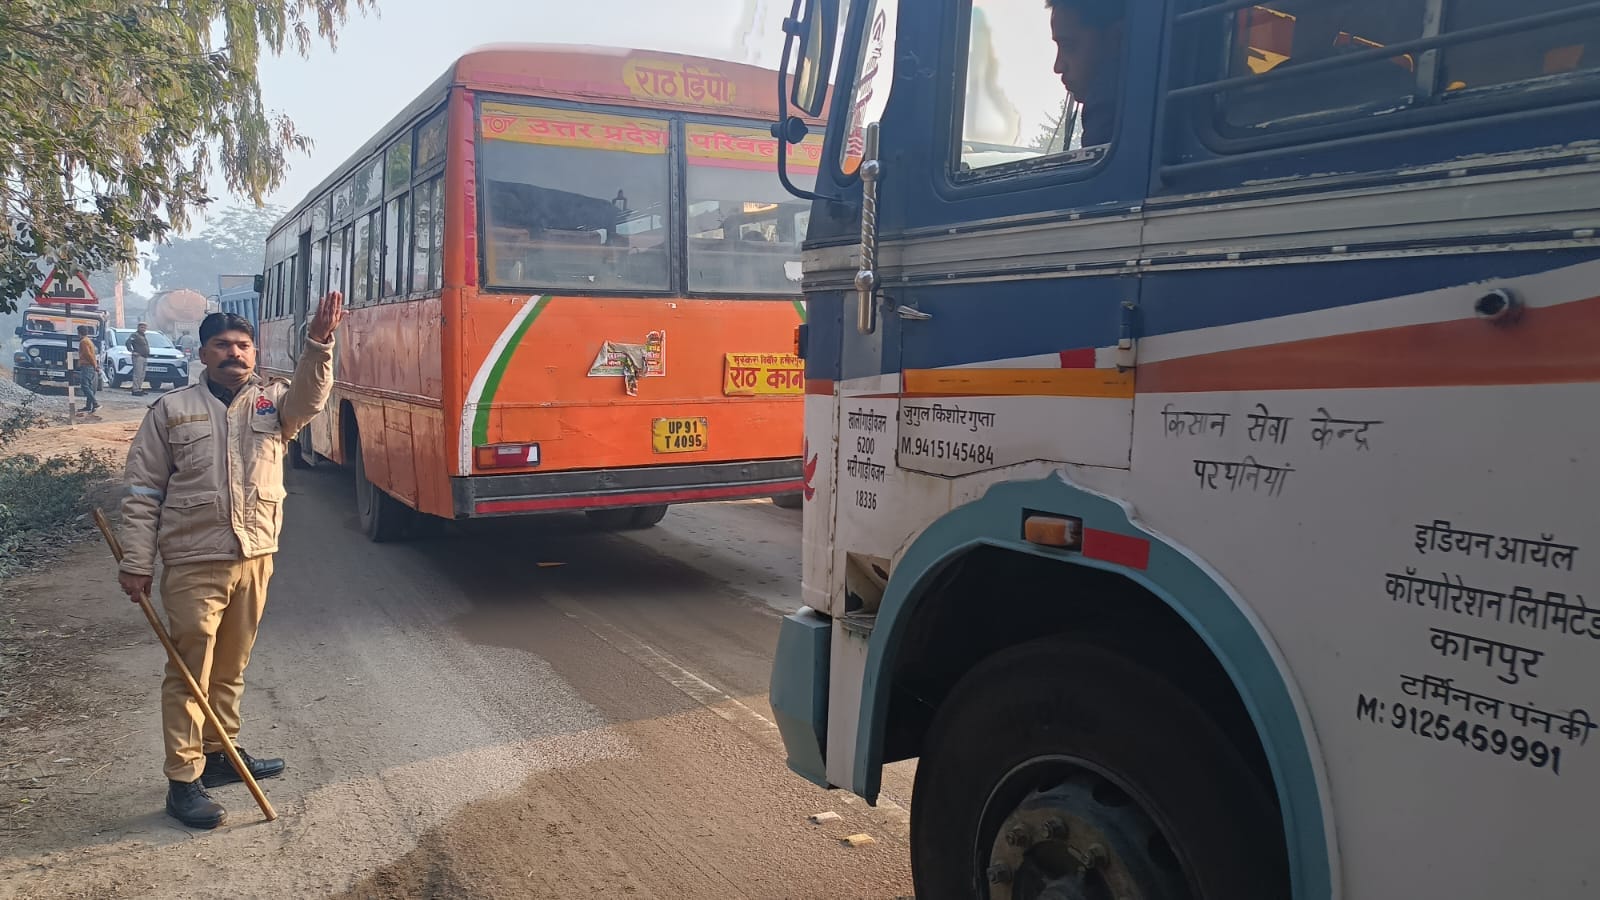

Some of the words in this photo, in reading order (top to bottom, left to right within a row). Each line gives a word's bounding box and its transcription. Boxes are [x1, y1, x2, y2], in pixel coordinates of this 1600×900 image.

[527, 118, 595, 139] उत्तर
[602, 121, 668, 145] प्रदेश
[730, 367, 761, 388] राठ
[766, 368, 804, 389] कान
[668, 422, 682, 434] UP
[684, 421, 698, 434] 91
[903, 406, 930, 427] जुगुल
[932, 403, 967, 424] किशोर
[968, 410, 996, 432] गुप्ता
[1161, 402, 1231, 438] किसान
[1247, 402, 1294, 444] सेवा
[1310, 407, 1384, 450] केन्द्र
[665, 436, 671, 448] T
[674, 435, 702, 448] 4095
[857, 436, 875, 455] 6200
[855, 490, 877, 510] 18336
[1385, 566, 1506, 621] कॉरपोरेशन
[1508, 586, 1600, 640] लिमिटेड
[1430, 626, 1545, 685] कानपुर
[1400, 674, 1505, 720] टर्मिनल
